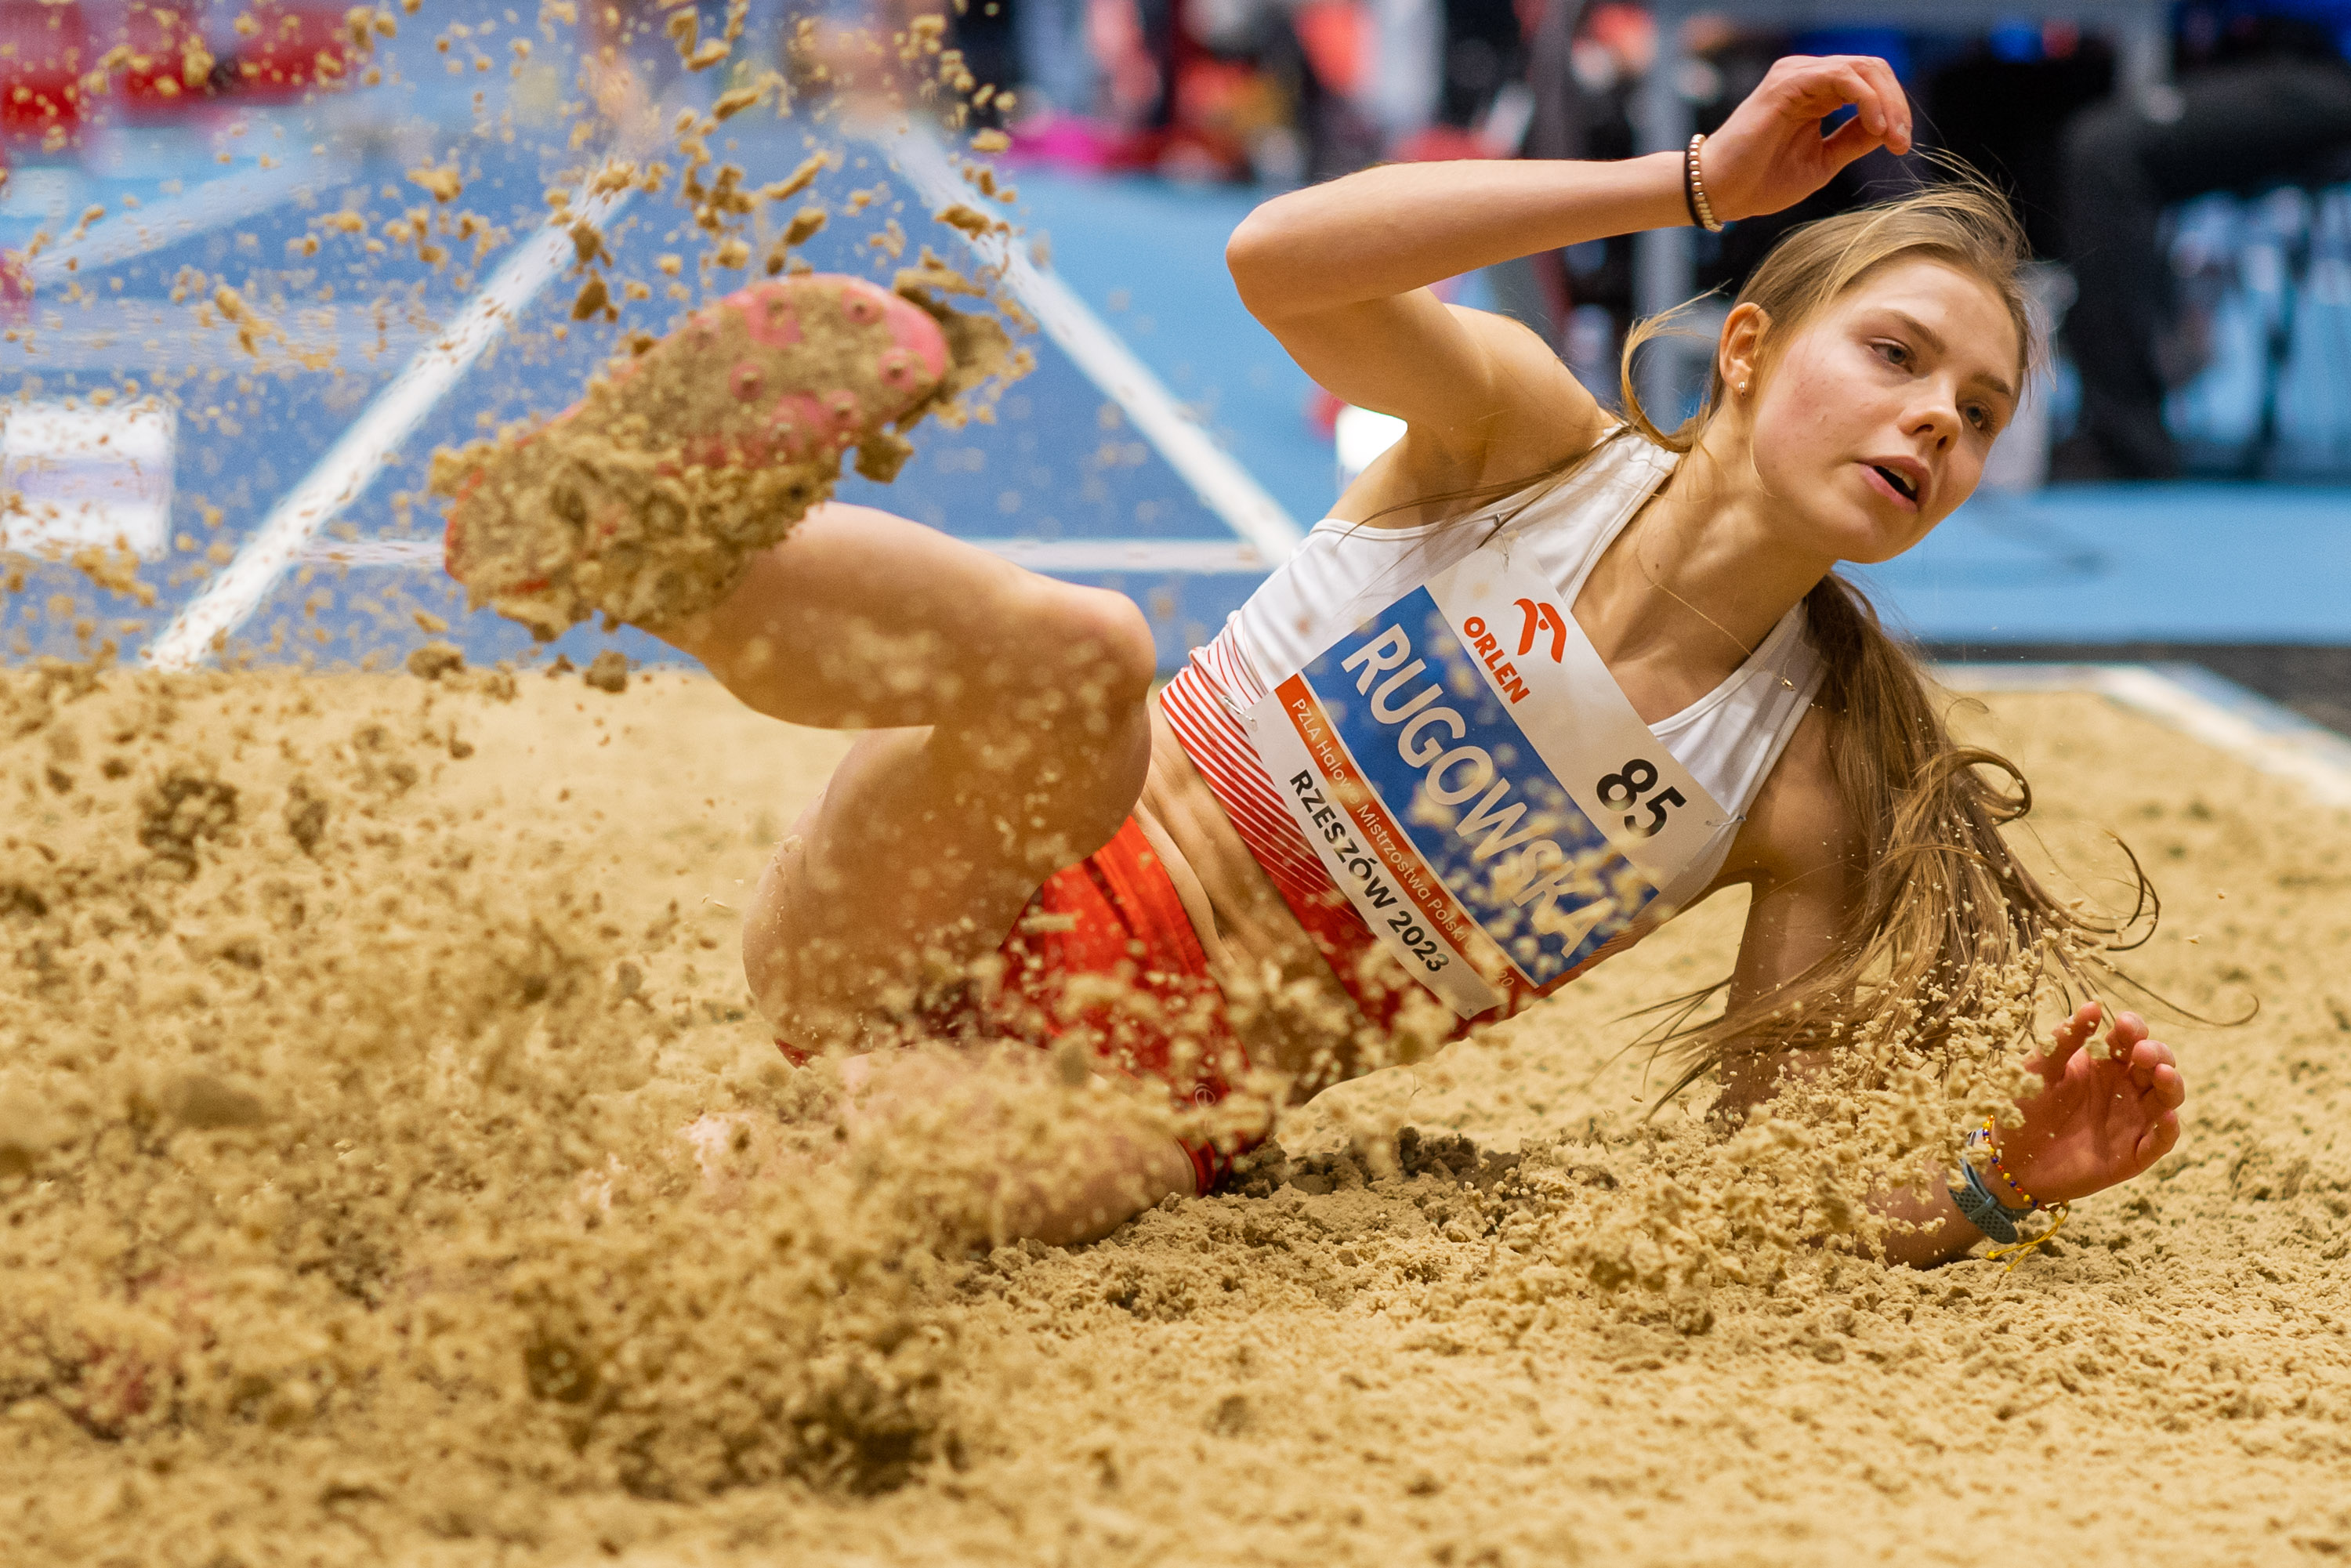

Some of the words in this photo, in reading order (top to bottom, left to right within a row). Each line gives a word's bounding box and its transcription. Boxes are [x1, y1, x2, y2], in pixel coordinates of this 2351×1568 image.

[1464, 616, 1530, 703] ORLEN
[1289, 770, 1398, 909] RZESZÓW
[1387, 910, 1449, 972] 2023
[1292, 699, 1320, 741] PZLA
[1316, 741, 1360, 803] Halowe
[1357, 804, 1432, 900] Mistrzostwa
[1428, 899, 1468, 940] Polski
[1341, 624, 1614, 958] RUGOWSKA
[1596, 759, 1686, 838] 85
